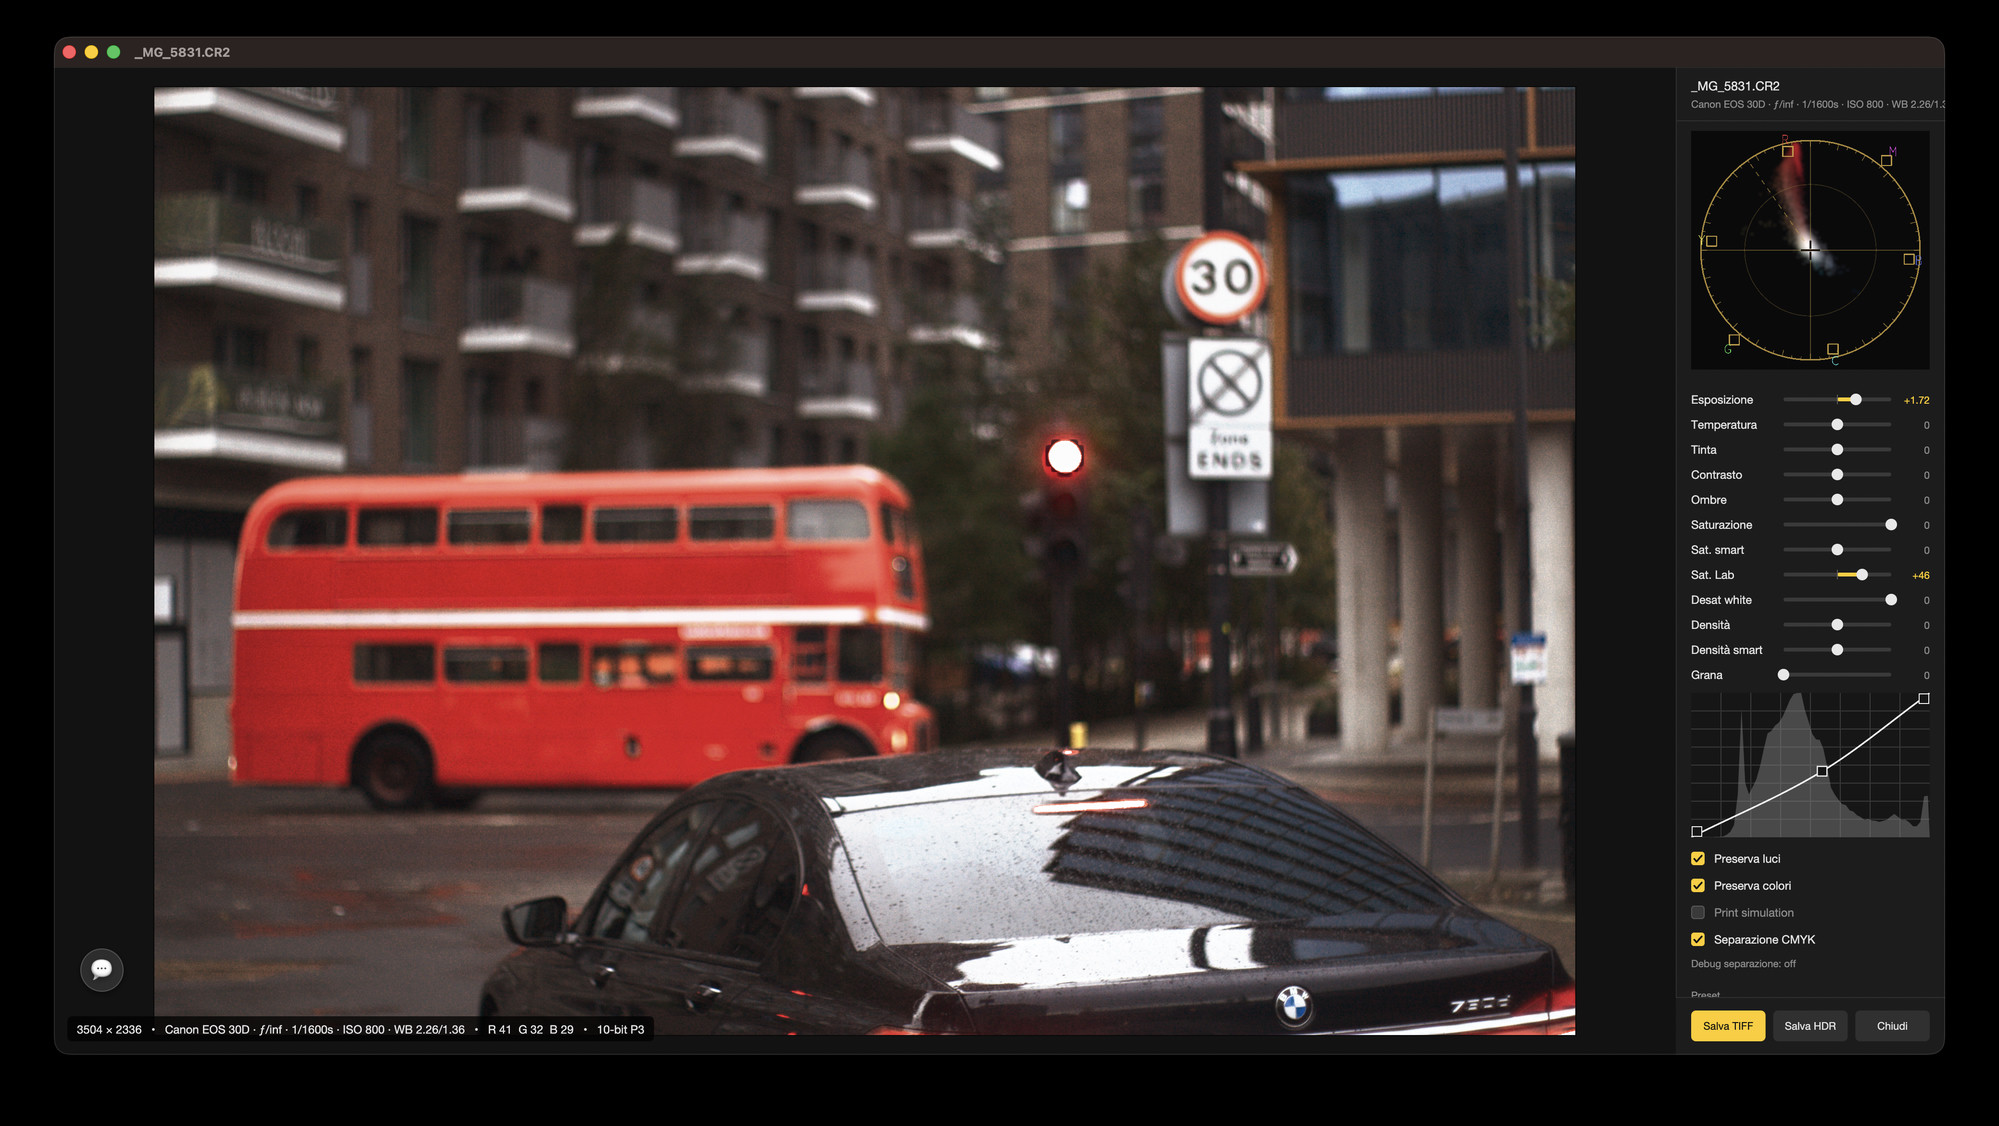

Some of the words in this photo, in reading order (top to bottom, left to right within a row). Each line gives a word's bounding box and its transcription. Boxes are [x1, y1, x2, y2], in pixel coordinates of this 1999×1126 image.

[133, 46, 231, 60] _MG_5831.CR2
[1690, 80, 1780, 93] _MG_5831.CR2
[1690, 99, 1722, 109] Canon
[1723, 99, 1745, 109] EOS
[1746, 99, 1766, 109] 30D
[1802, 99, 1839, 109] 1/1600s
[1846, 99, 1865, 109] ISO
[1866, 99, 1884, 109] 800
[1891, 99, 1909, 109] WB
[1781, 133, 1789, 145] R
[1888, 146, 1897, 157] M
[1190, 258, 1254, 296] 30
[1723, 343, 1732, 354] G
[1831, 355, 1840, 366] C
[1691, 394, 1754, 407] Esposizione
[1903, 395, 1931, 405] +1.72
[1690, 419, 1758, 432] Temperatura
[1923, 420, 1931, 430] 0
[1690, 444, 1718, 455] Tinta
[1923, 445, 1931, 455] 0
[1196, 450, 1263, 471] ENDS
[1690, 469, 1743, 480] Contrasto
[1923, 470, 1931, 480] 0
[1690, 494, 1728, 505] Ombre
[1923, 495, 1931, 505] 0
[1690, 519, 1753, 530] Saturazione
[1923, 520, 1931, 530] 0
[1690, 544, 1712, 555] Sat.
[1714, 545, 1745, 555] smart
[1923, 545, 1931, 555] 0
[1690, 569, 1712, 580] Sat.
[1714, 569, 1735, 580] Lab
[1912, 570, 1931, 580] +46
[1691, 594, 1722, 605] Desat
[1723, 594, 1753, 605] white
[1923, 595, 1931, 605] 0
[1691, 619, 1731, 630] Densità
[1923, 620, 1931, 630] 0
[1691, 644, 1731, 655] Densità
[1732, 645, 1764, 655] smart
[1923, 645, 1931, 655] 0
[1690, 669, 1724, 681] Grana
[1923, 670, 1931, 680] 0
[1714, 853, 1761, 864] Preserva
[1762, 853, 1781, 864] luci
[1714, 880, 1761, 891] Preserva
[1762, 880, 1792, 891] colori
[1714, 907, 1739, 918] Print
[1741, 907, 1795, 918] simulation
[1713, 934, 1780, 947] Separazione
[1781, 934, 1816, 945] CMYK
[1691, 959, 1722, 971] Debug
[1723, 959, 1782, 971] separazione:
[1783, 959, 1797, 968] off
[1277, 986, 1310, 1003] BMW
[76, 1024, 103, 1035] 3504
[115, 1024, 143, 1035] 2336
[164, 1024, 200, 1035] Canon
[202, 1024, 226, 1035] EOS
[228, 1024, 250, 1035] 30D
[291, 1024, 334, 1035] 1/1600s
[342, 1024, 363, 1035] ISO
[364, 1024, 386, 1035] 800
[393, 1024, 414, 1035] WB
[415, 1024, 466, 1035] 2.26/1.36
[488, 1024, 497, 1035] R
[498, 1024, 511, 1035] 41
[518, 1024, 528, 1035] G
[529, 1024, 544, 1035] 32
[549, 1024, 558, 1035] B
[560, 1024, 574, 1035] 29
[597, 1024, 628, 1035] 10-bit
[630, 1024, 645, 1035] P3
[1703, 1020, 1730, 1031] Salva
[1731, 1021, 1754, 1031] TIFF
[1784, 1021, 1812, 1031] Salva
[1813, 1021, 1837, 1031] HDR
[1876, 1021, 1908, 1031] Chiudi
